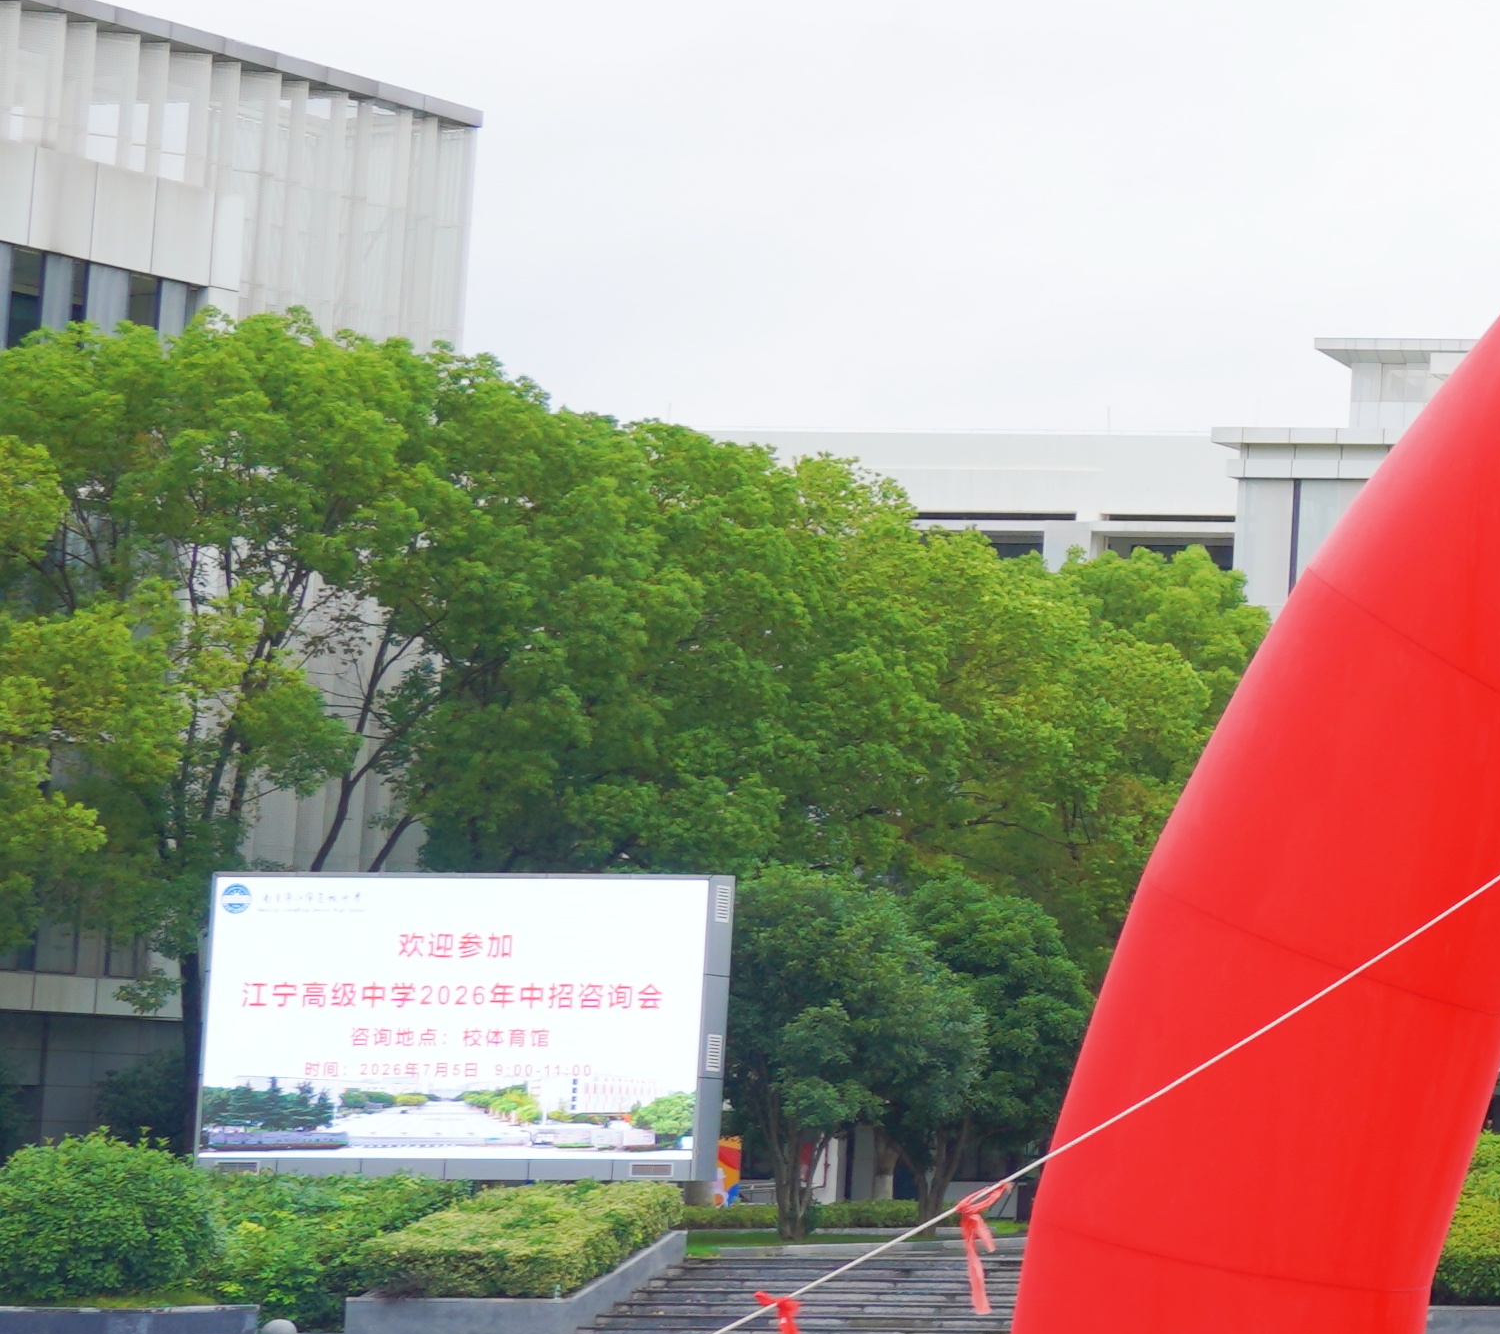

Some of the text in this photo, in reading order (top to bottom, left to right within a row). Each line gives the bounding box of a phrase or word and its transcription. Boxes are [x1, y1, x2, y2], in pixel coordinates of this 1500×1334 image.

[398, 932, 514, 959] 欢迎参加
[241, 981, 664, 1010] 江宁高级中学2026年中招咨询会
